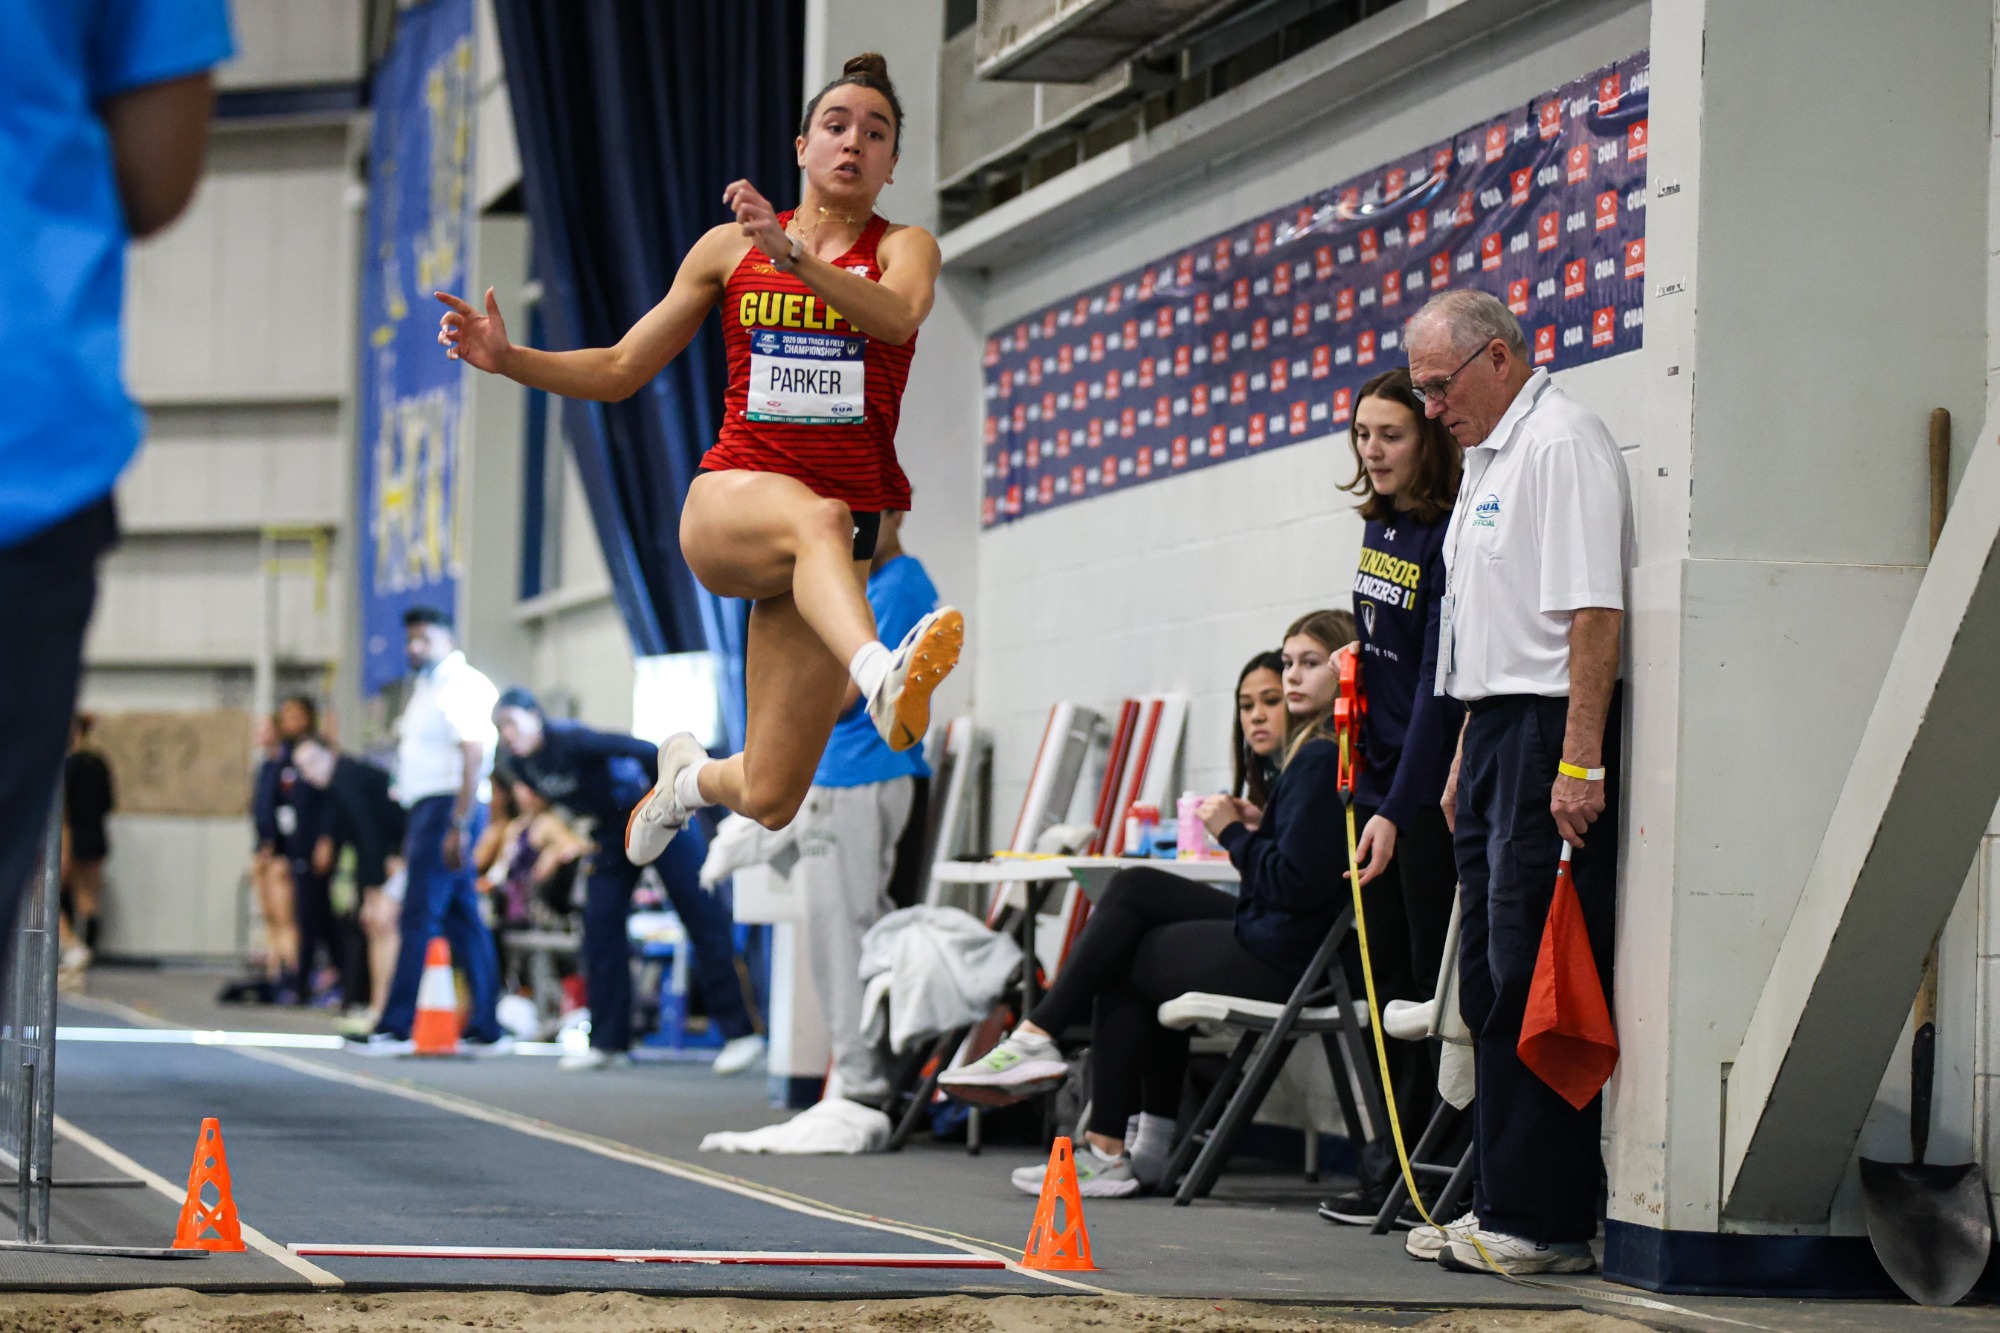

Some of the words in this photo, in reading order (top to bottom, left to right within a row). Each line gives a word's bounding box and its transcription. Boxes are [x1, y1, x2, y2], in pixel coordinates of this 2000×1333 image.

[1598, 141, 1618, 164] OUA
[1537, 165, 1558, 187] OUA
[1566, 211, 1586, 233] OUA
[1594, 258, 1616, 280] OUA
[1536, 277, 1556, 300] OUA
[740, 291, 859, 332] GUELP
[1623, 307, 1644, 329] OUA
[808, 337, 825, 347] TRACK
[830, 340, 845, 349] FIELD
[1563, 325, 1584, 347] OUA
[784, 344, 841, 357] CHAMPIONSHIPS
[770, 366, 841, 395] PARKER
[1476, 503, 1499, 511] OUA
[1472, 519, 1495, 527] OFFICIAL
[1354, 573, 1402, 606] ANCERS
